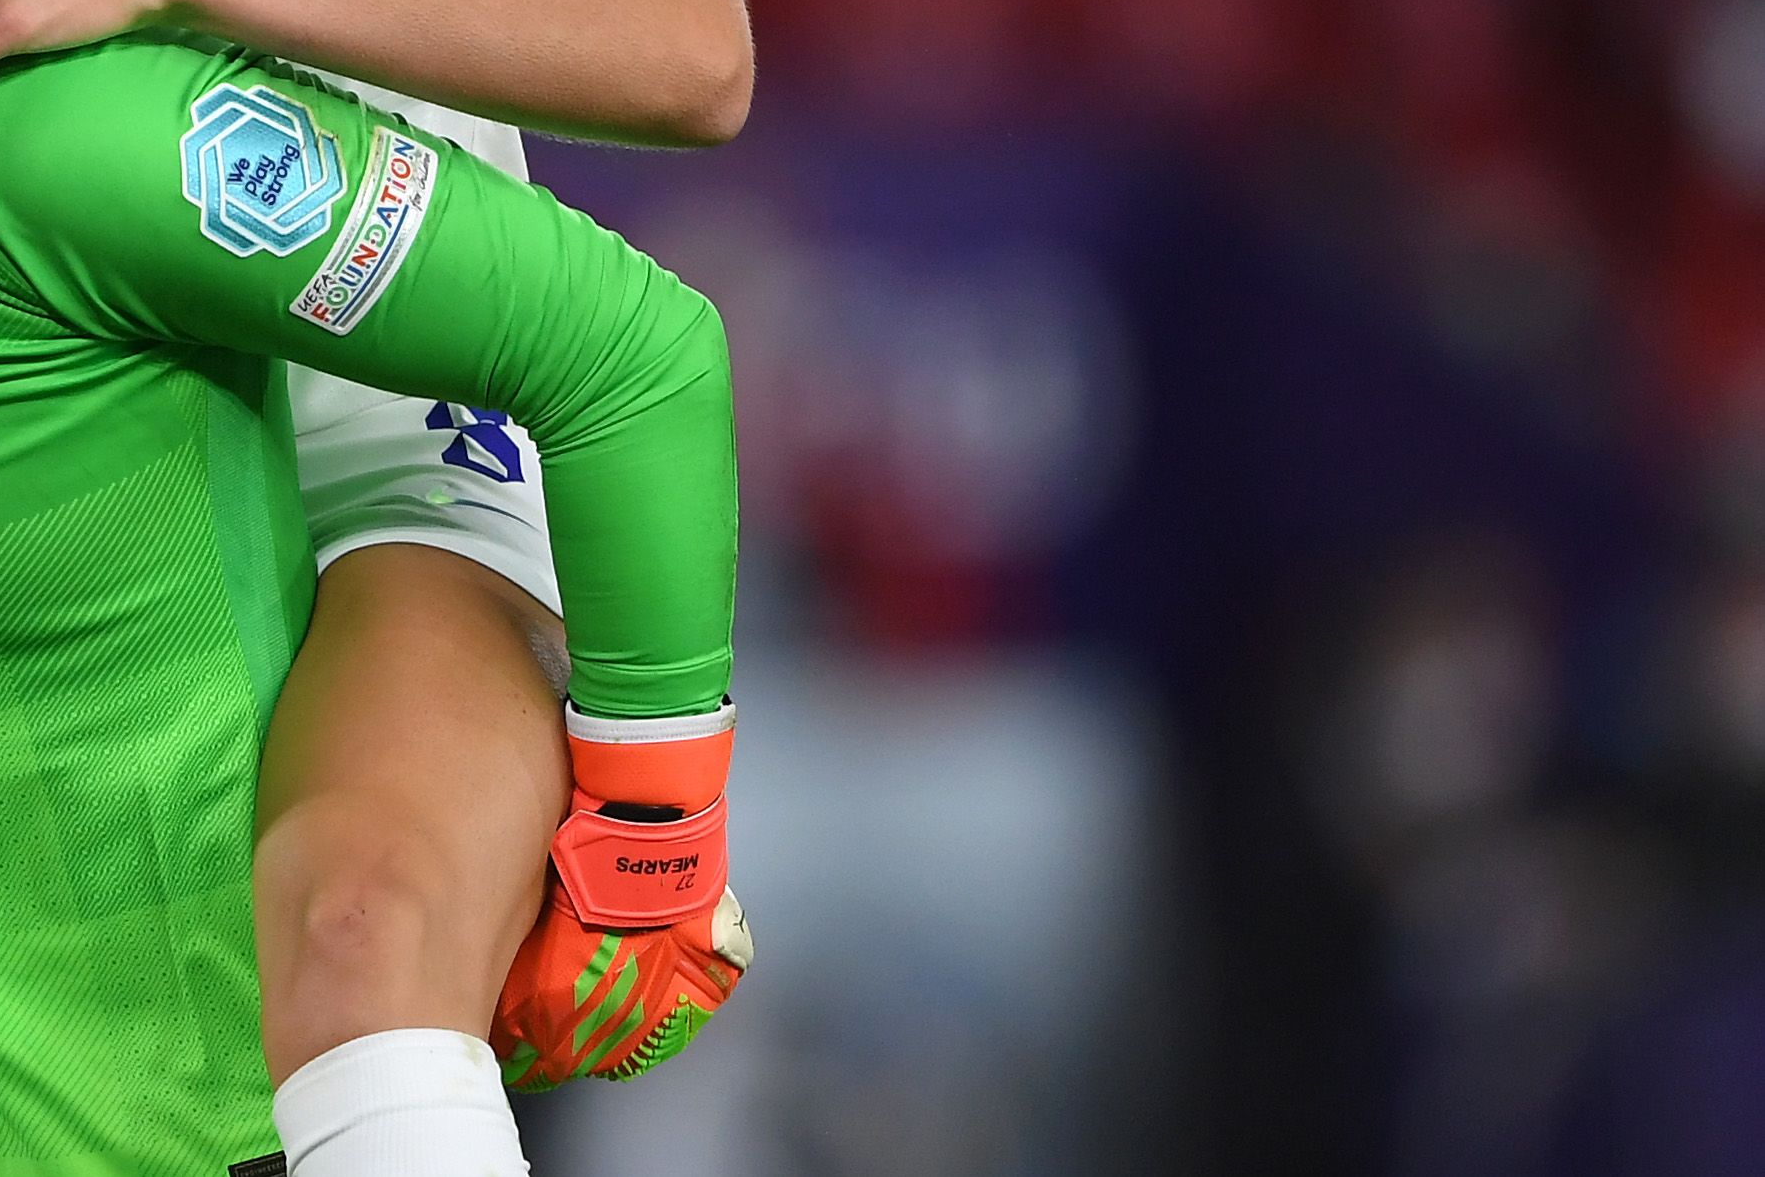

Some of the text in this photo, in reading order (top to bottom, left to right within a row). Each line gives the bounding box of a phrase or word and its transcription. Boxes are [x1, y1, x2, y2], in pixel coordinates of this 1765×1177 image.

[227, 158, 250, 182] We
[244, 154, 276, 197] Play
[261, 144, 301, 206] Strong
[298, 273, 333, 311] UEFA
[615, 853, 699, 875] MEARPS
[675, 872, 696, 892] 27
